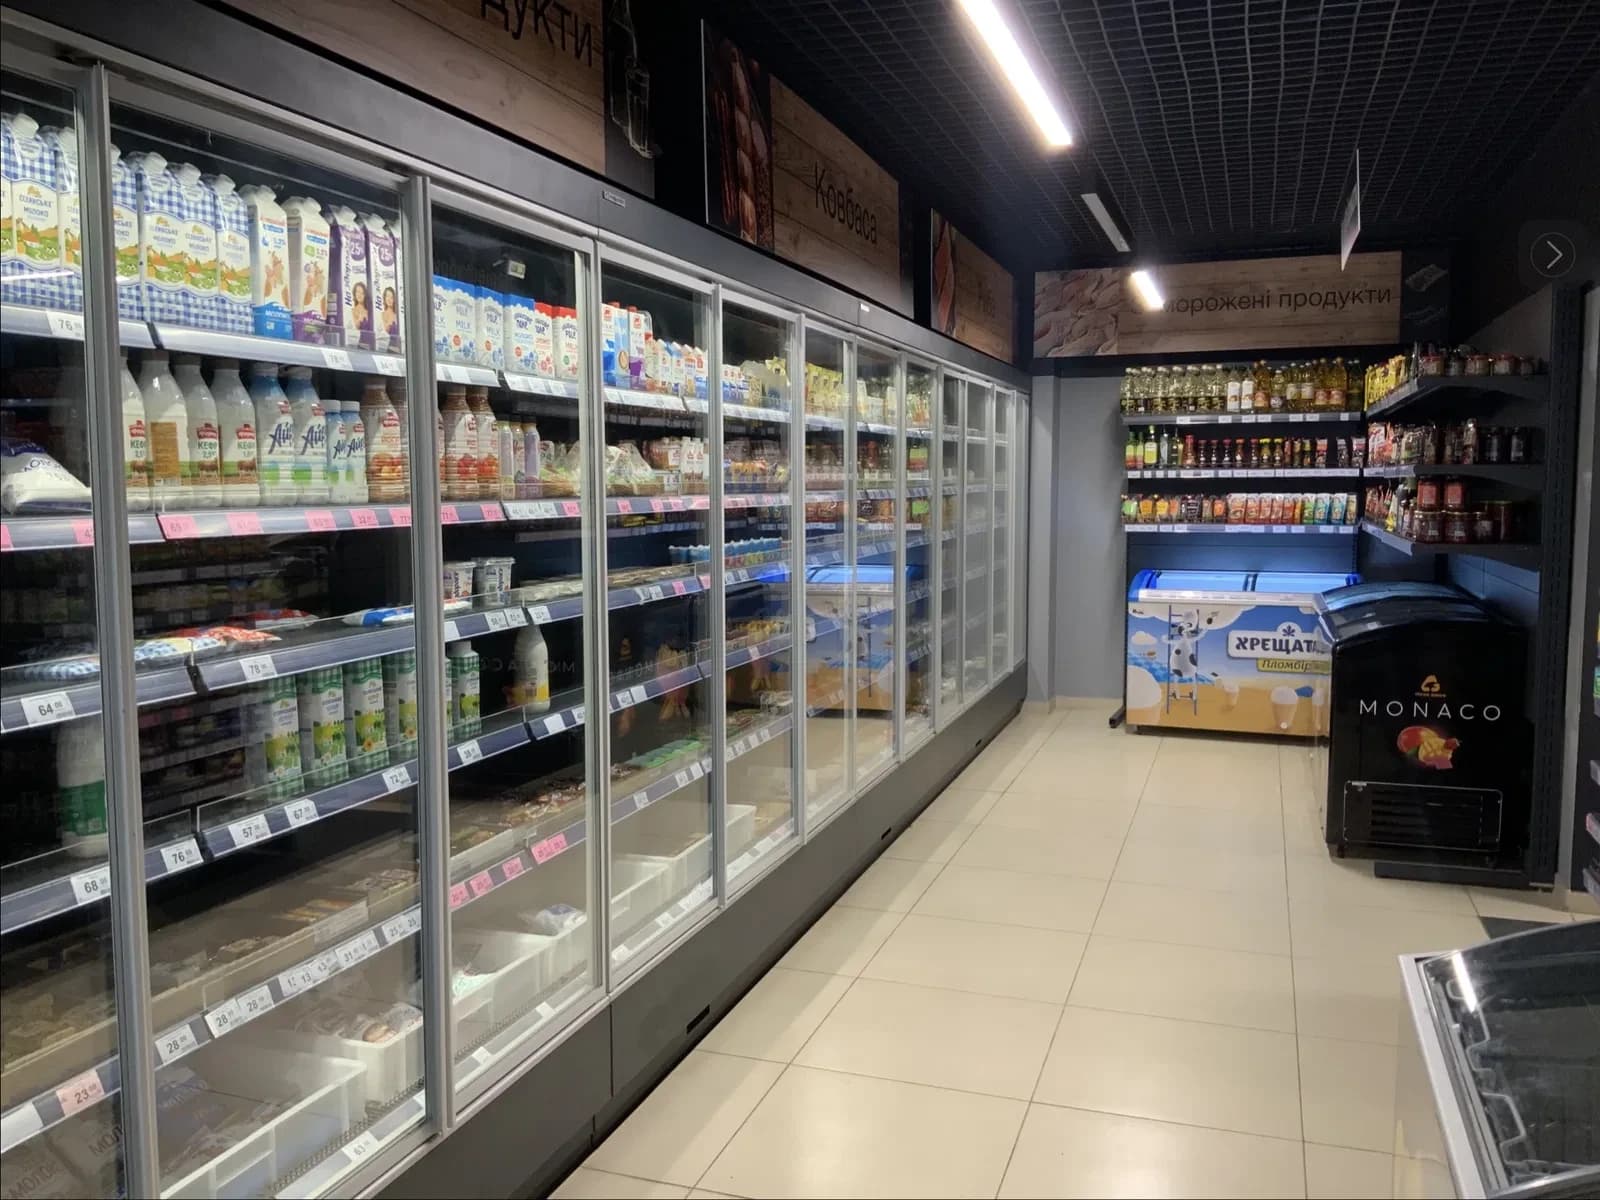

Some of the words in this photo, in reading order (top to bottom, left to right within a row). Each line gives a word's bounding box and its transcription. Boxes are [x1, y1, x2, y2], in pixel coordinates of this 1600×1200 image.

[815, 160, 877, 244] Ковбаса
[1279, 288, 1391, 313] продукти
[38, 703, 53, 716] 64
[1359, 699, 1501, 721] MONACO
[242, 826, 253, 838] 57
[171, 851, 185, 864] 76
[84, 880, 98, 893] 68
[246, 1000, 258, 1012] 28
[216, 1013, 228, 1027] 28
[166, 1040, 180, 1054] 28
[74, 1088, 89, 1104] 23
